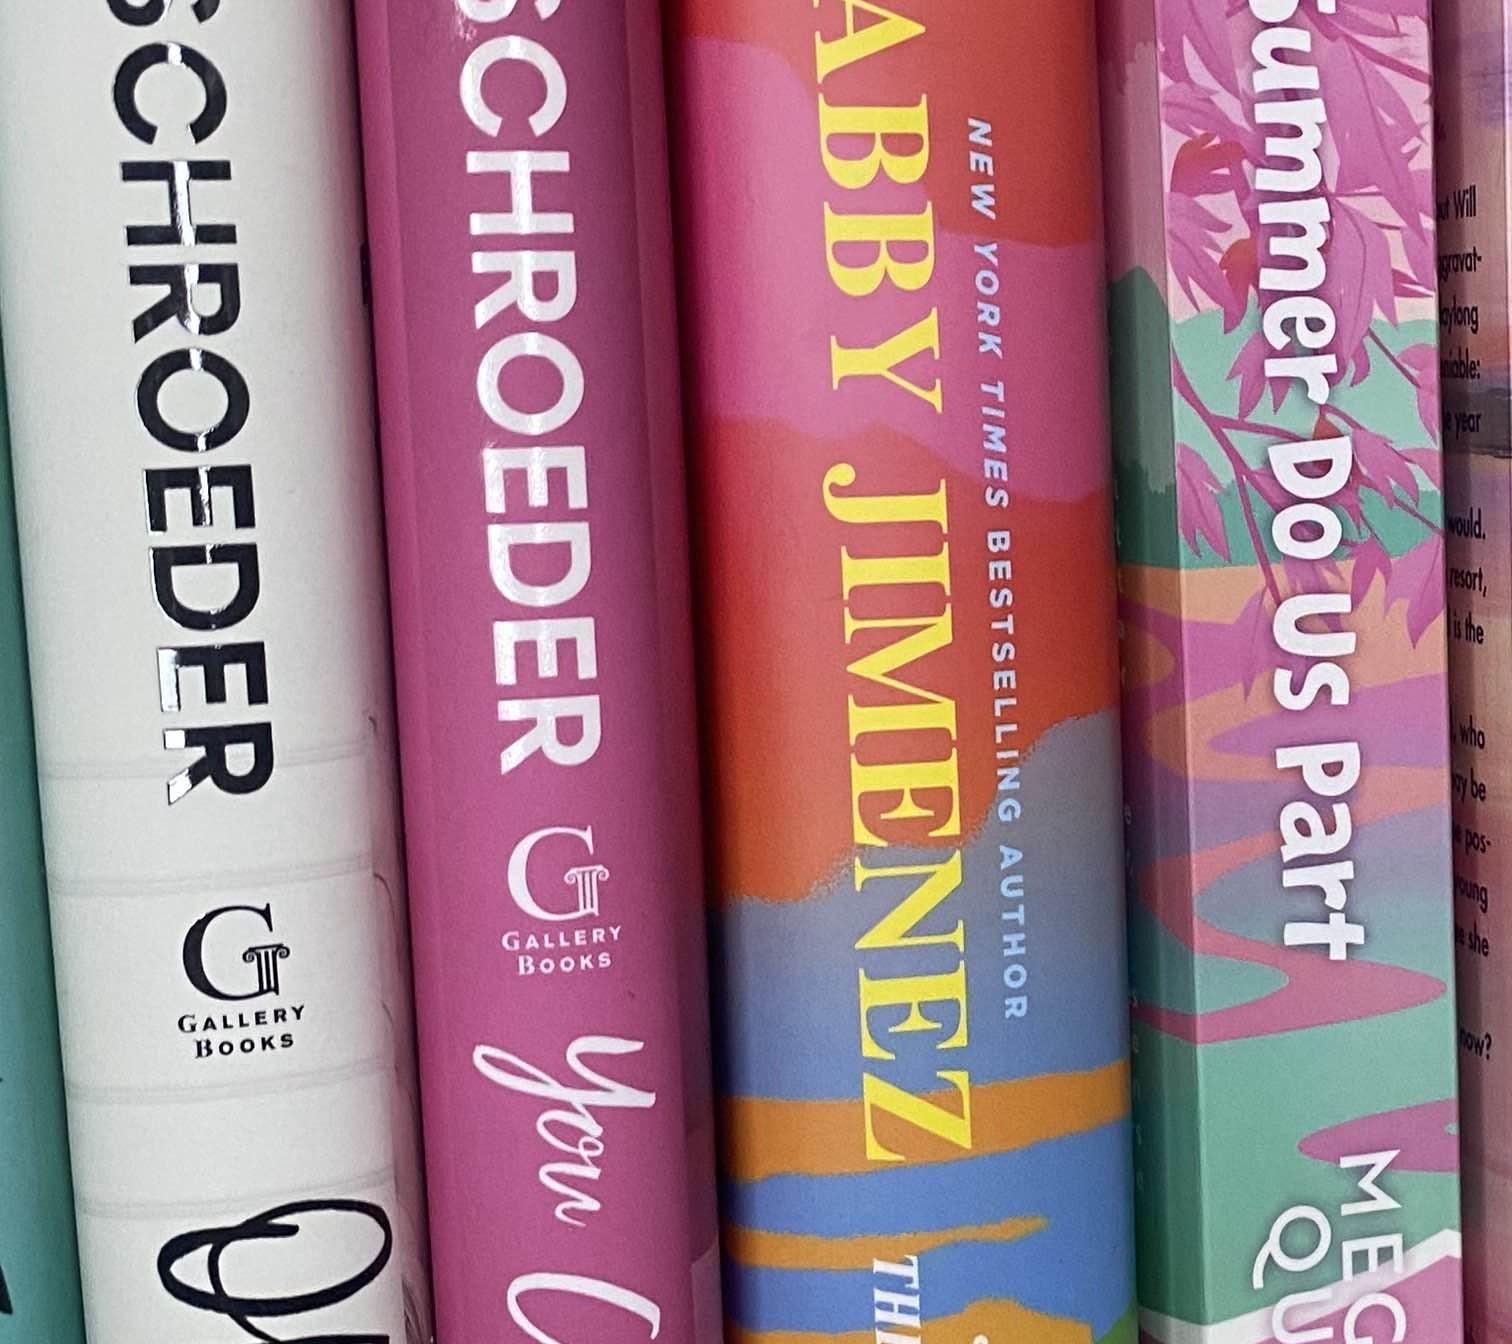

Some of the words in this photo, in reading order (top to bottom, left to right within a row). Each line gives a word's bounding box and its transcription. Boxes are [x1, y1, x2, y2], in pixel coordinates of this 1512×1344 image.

[967, 117, 997, 221] NEW
[973, 241, 1001, 356] YORK
[979, 380, 1010, 510] TIMES
[1267, 435, 1354, 561] Do
[985, 529, 1022, 825] BESTSELLING
[822, 461, 973, 1163] JIMENEZ
[1275, 741, 1365, 961] Part
[502, 925, 622, 953] GALLERY
[517, 951, 612, 976] BOOKS
[999, 849, 1029, 1021] AUTHOR
[178, 1004, 305, 1035] GALLERY
[195, 1032, 294, 1059] BOOKS
